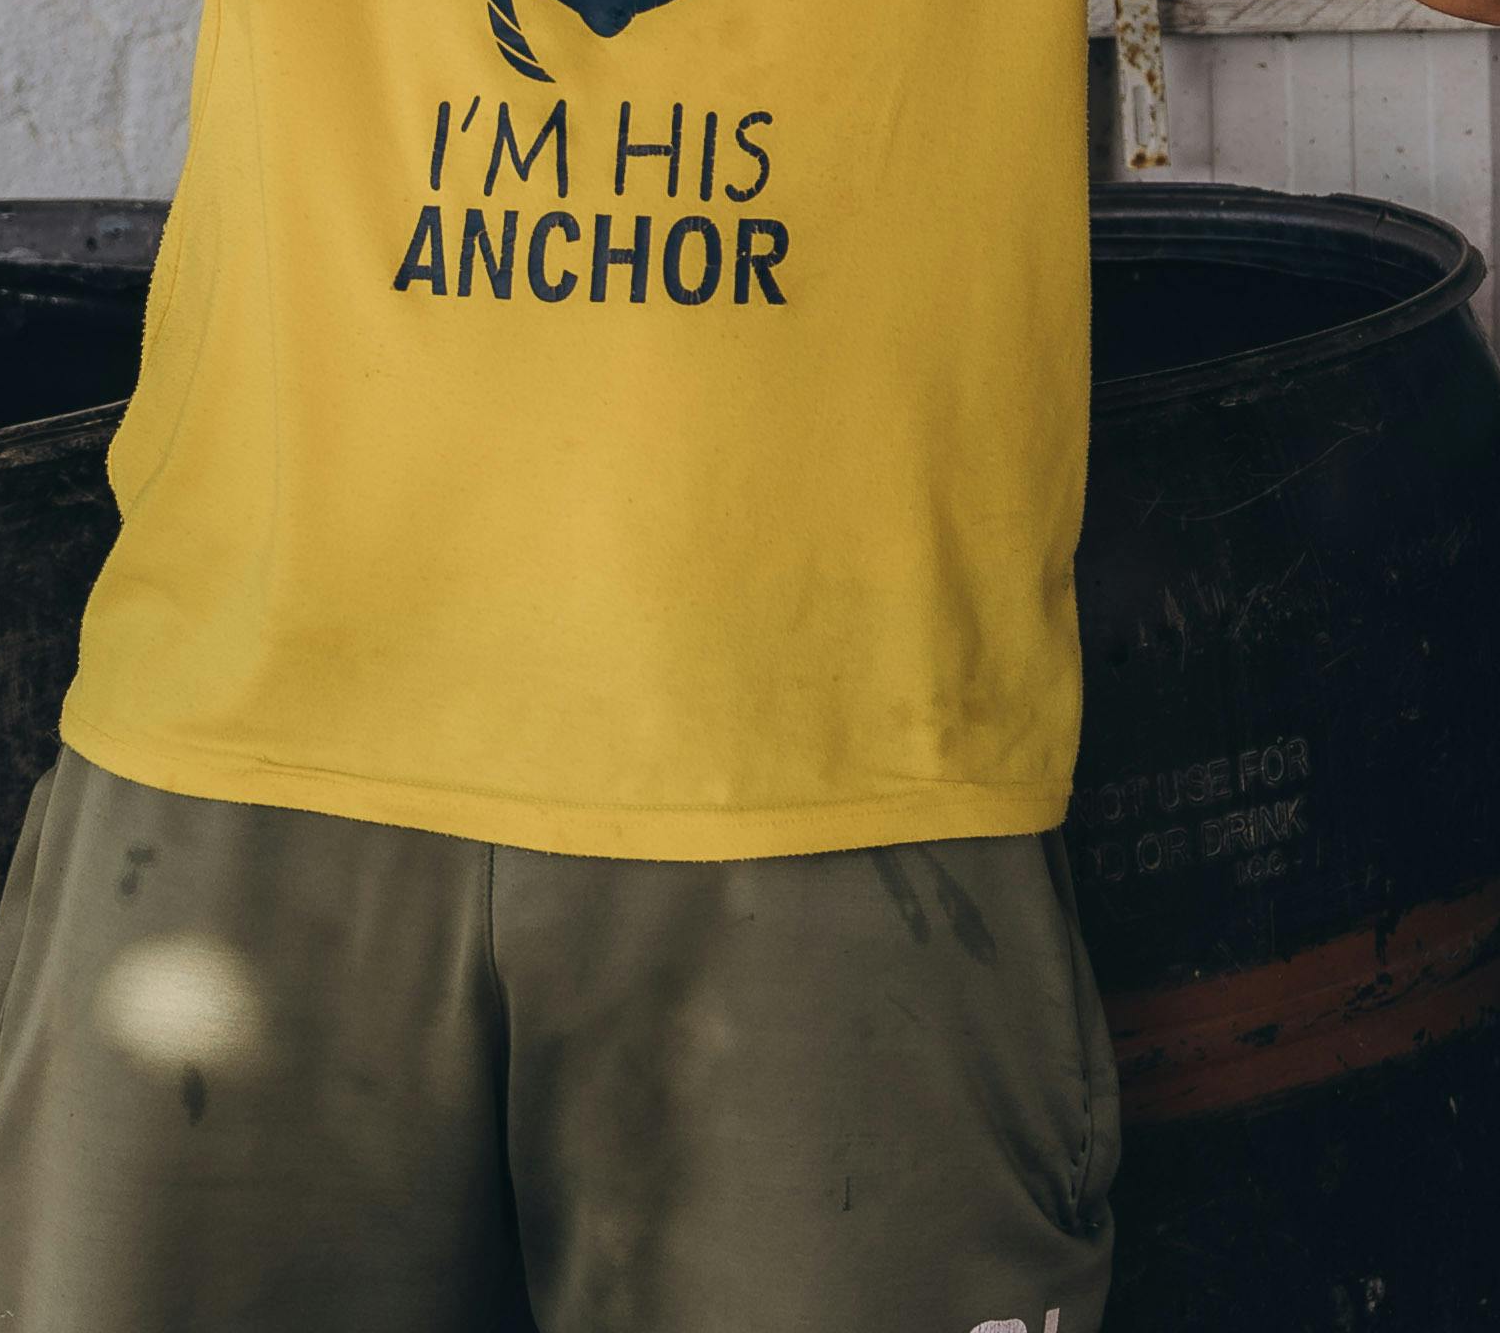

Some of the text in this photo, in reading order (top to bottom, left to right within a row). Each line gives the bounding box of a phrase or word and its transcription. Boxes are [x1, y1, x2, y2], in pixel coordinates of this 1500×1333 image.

[429, 95, 773, 203] I'M HIS
[393, 204, 790, 306] ANCHOR
[1155, 756, 1233, 813] USE
[1237, 737, 1311, 793] FOR
[1135, 826, 1192, 874] OR
[1200, 797, 1309, 860] DRINK
